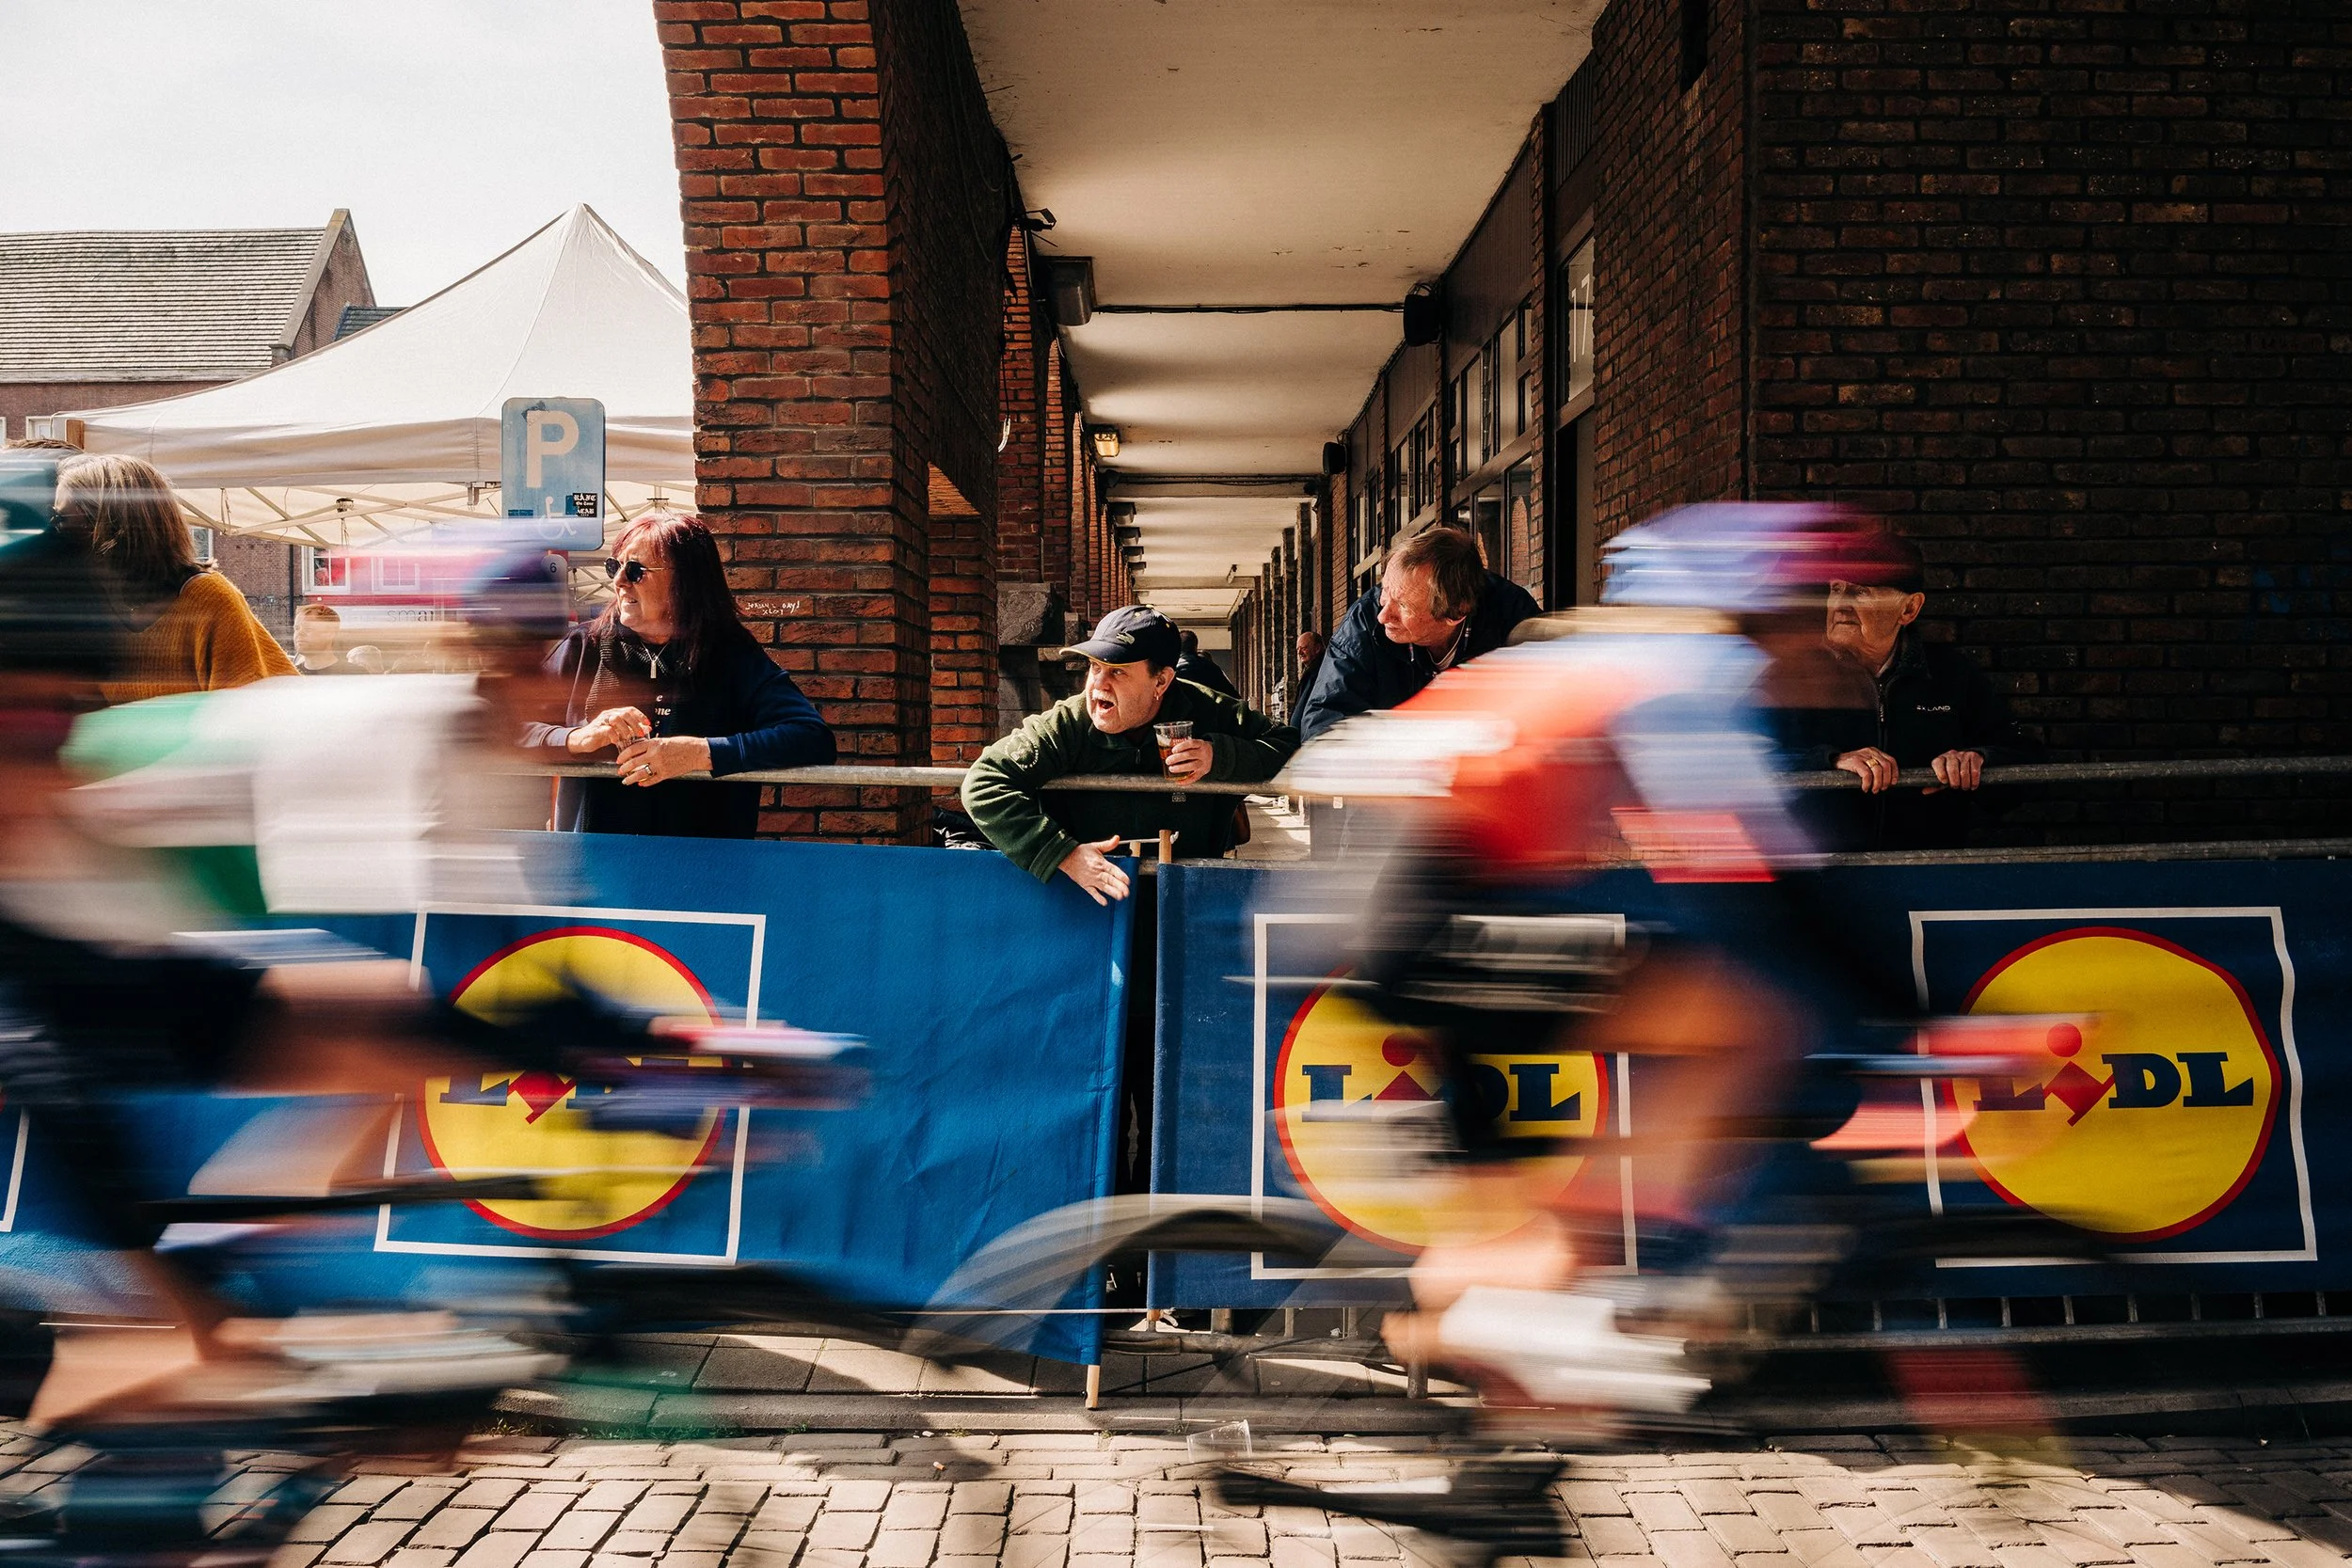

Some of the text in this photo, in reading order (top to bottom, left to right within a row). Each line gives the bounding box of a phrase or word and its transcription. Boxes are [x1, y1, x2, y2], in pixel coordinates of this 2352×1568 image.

[1571, 273, 1590, 363] 17
[527, 411, 580, 488] P
[549, 562, 557, 573] 6
[387, 610, 435, 623] smar
